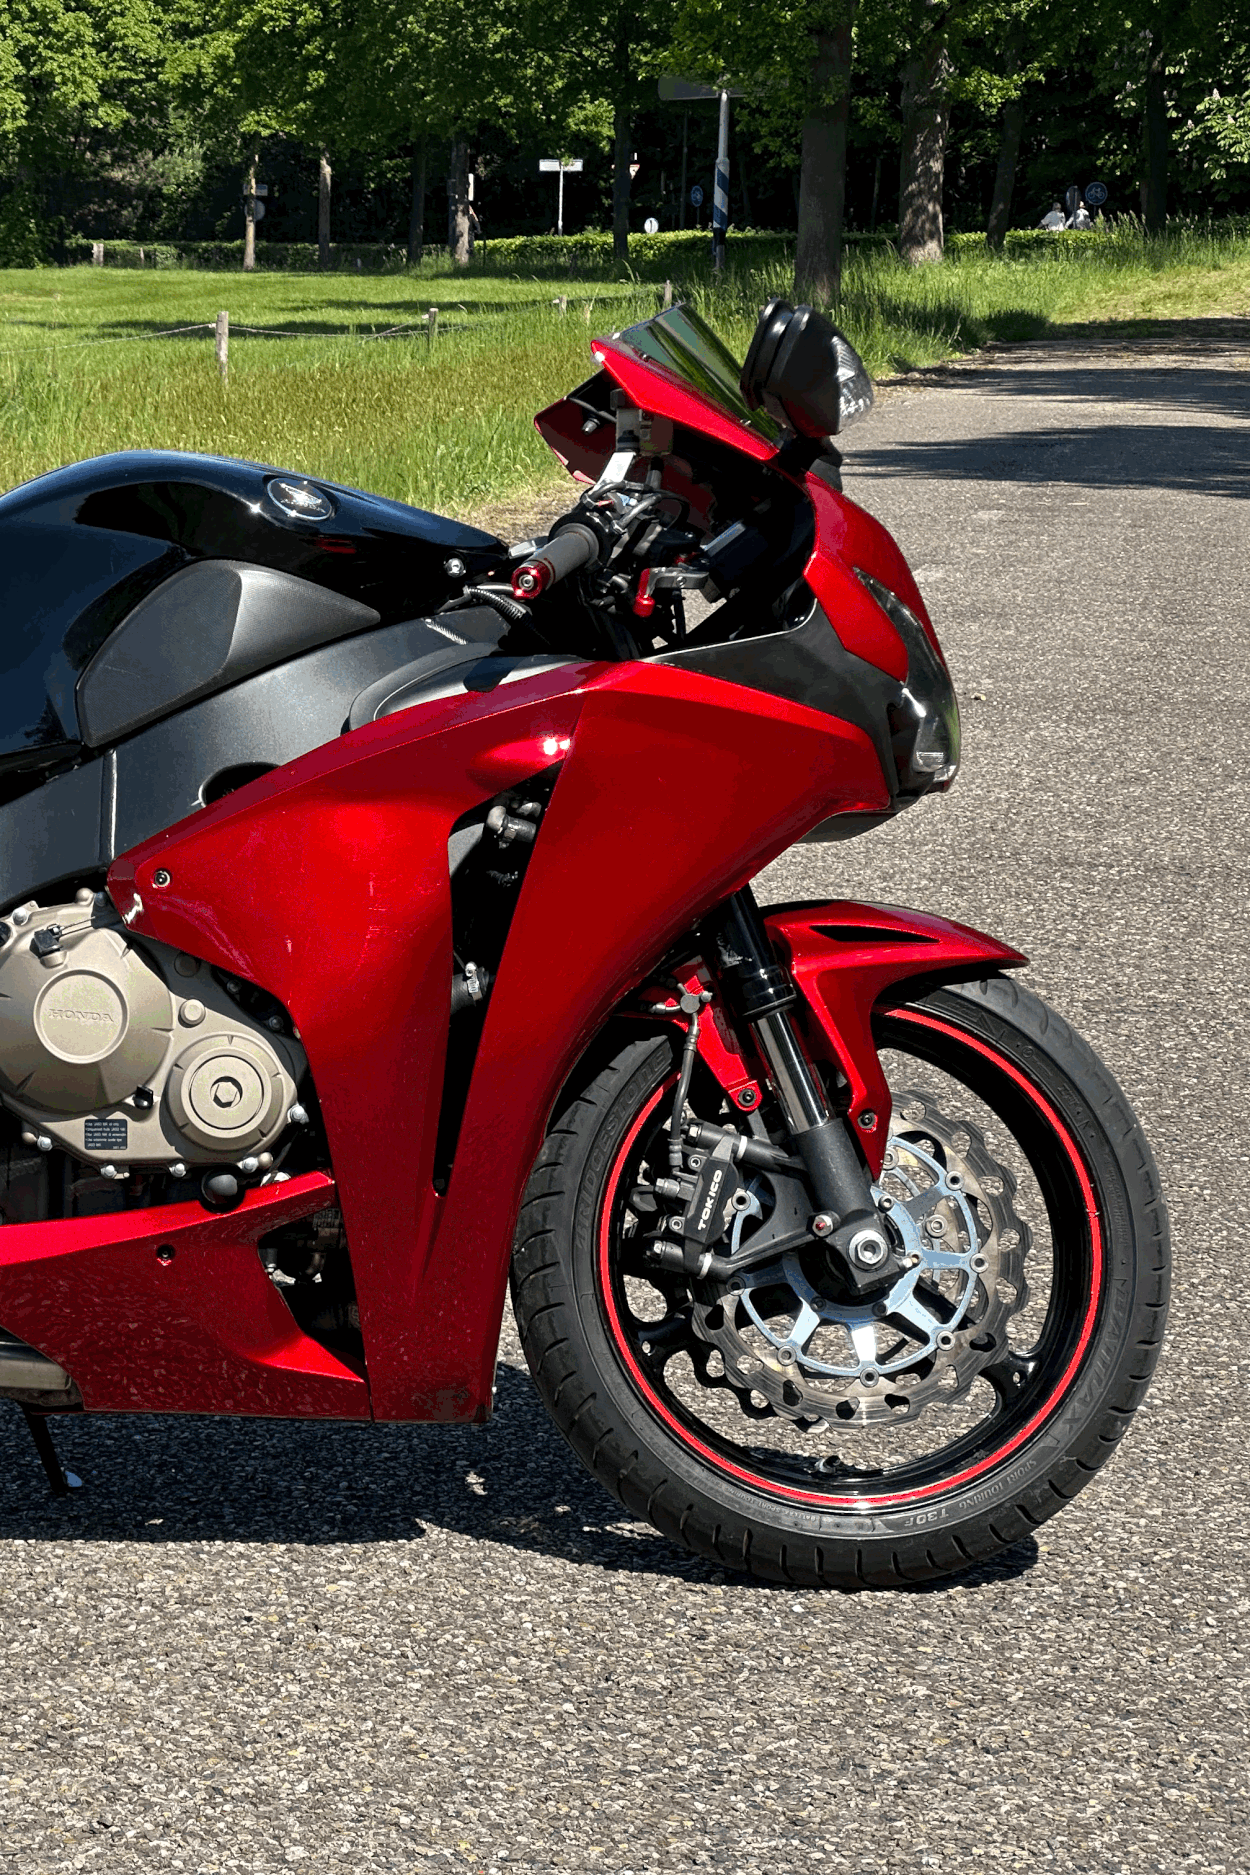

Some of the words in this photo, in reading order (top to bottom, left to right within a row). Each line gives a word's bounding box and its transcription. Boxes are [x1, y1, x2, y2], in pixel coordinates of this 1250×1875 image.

[49, 1008, 114, 1023] HONDA
[576, 1051, 667, 1250] BRIDGESTONE
[698, 1169, 723, 1230] TOKICO
[1006, 1460, 1037, 1486] SPORT
[959, 1482, 1004, 1510] TOURING
